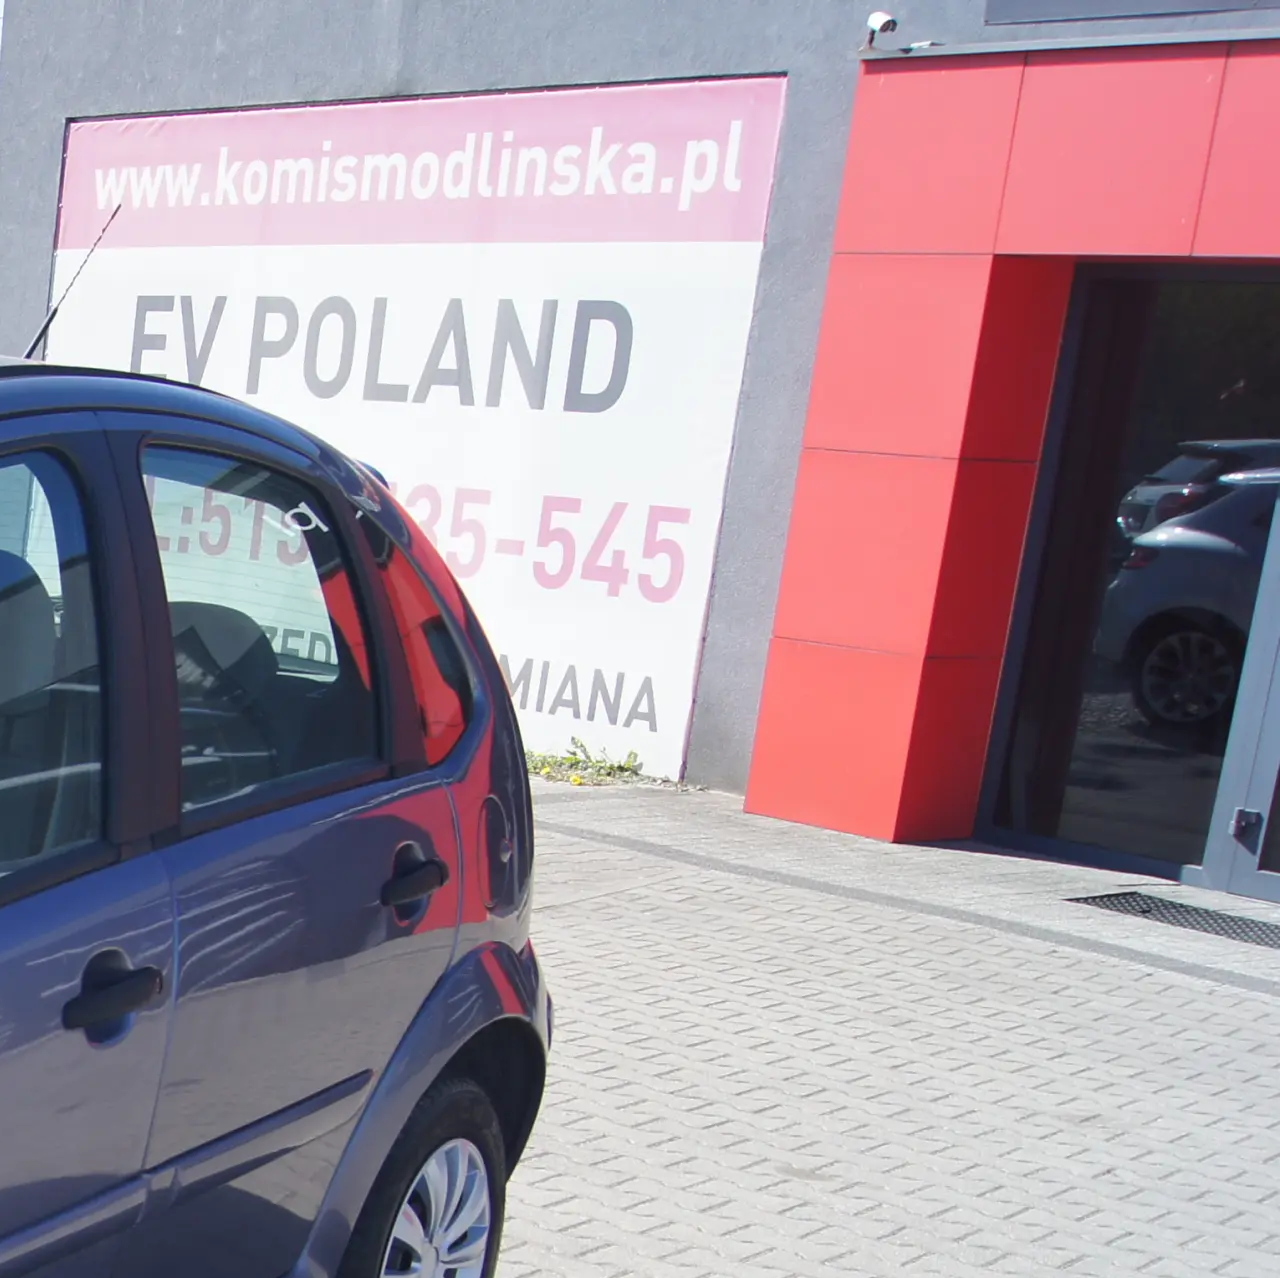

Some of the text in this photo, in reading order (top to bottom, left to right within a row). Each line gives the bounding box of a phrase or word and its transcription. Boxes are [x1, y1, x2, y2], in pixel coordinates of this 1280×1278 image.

[94, 120, 742, 212] www.komismodlinska.pl
[129, 295, 633, 413] EV POLAND
